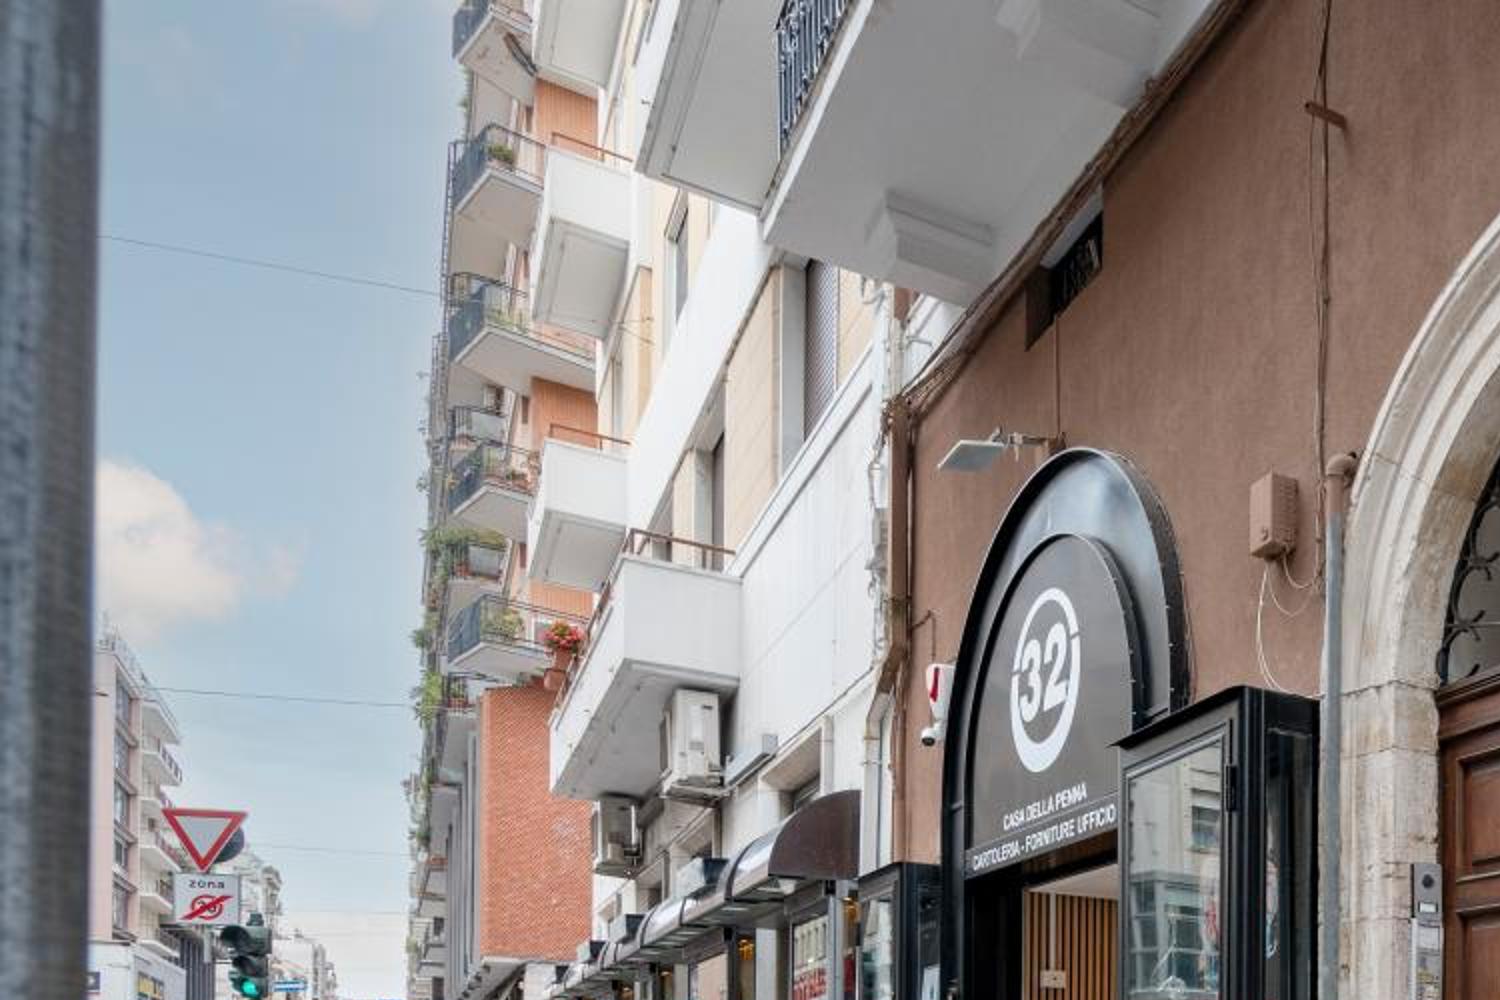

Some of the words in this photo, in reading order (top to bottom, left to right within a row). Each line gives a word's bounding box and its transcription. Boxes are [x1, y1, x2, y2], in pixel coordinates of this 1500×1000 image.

[1019, 621, 1069, 723] 32
[1003, 809, 1025, 831] CASA
[1025, 795, 1055, 821] DELLA
[1055, 782, 1088, 811] PENNA
[972, 840, 1021, 871] CARTOLERIA
[1025, 818, 1075, 851] FORNITURE
[1077, 803, 1117, 834] UFFICIO
[188, 880, 225, 889] zona
